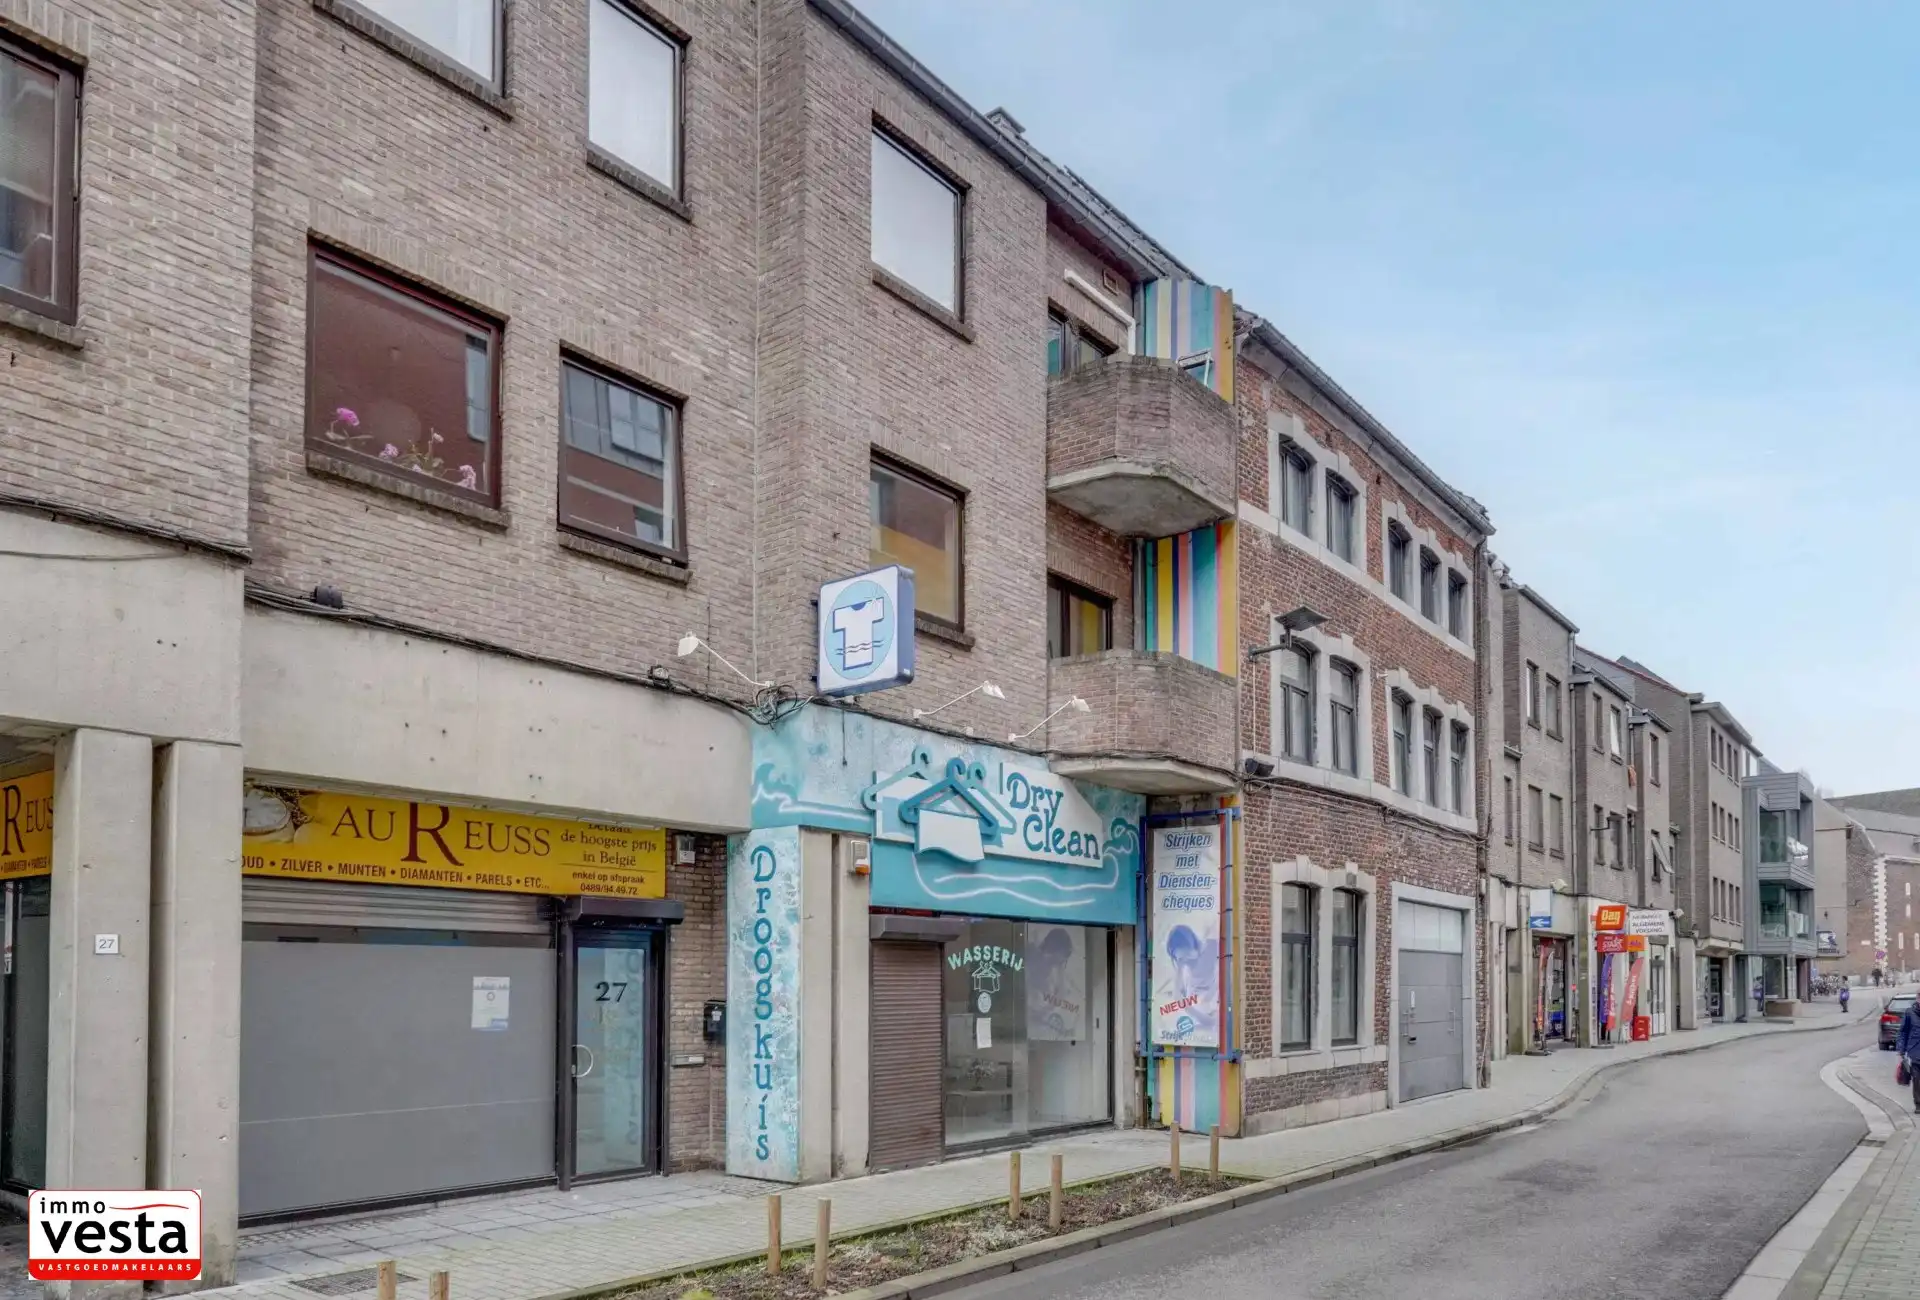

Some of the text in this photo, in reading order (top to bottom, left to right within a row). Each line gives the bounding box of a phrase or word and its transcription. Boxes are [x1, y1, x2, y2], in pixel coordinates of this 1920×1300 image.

[1006, 772, 1064, 829] Dry
[560, 829, 657, 853] de hoogste prijs
[1023, 808, 1101, 860] Clean
[1164, 832, 1212, 850] Strijken
[583, 850, 637, 867] in België
[1175, 855, 1199, 868] met
[280, 858, 322, 872] ZILVER
[338, 862, 386, 877] MUNTEN
[400, 867, 463, 883] DIAMANTEN
[475, 873, 513, 886] PARELS
[572, 870, 645, 885] enkel op afspraak
[1159, 872, 1217, 889] Diensten-
[1162, 893, 1214, 911] cheques
[99, 939, 115, 949] 27
[948, 945, 1025, 971] WASSERIJ
[595, 981, 628, 1003] 27
[750, 845, 777, 1161] Droogkuis
[1159, 995, 1199, 1016] NIEUW
